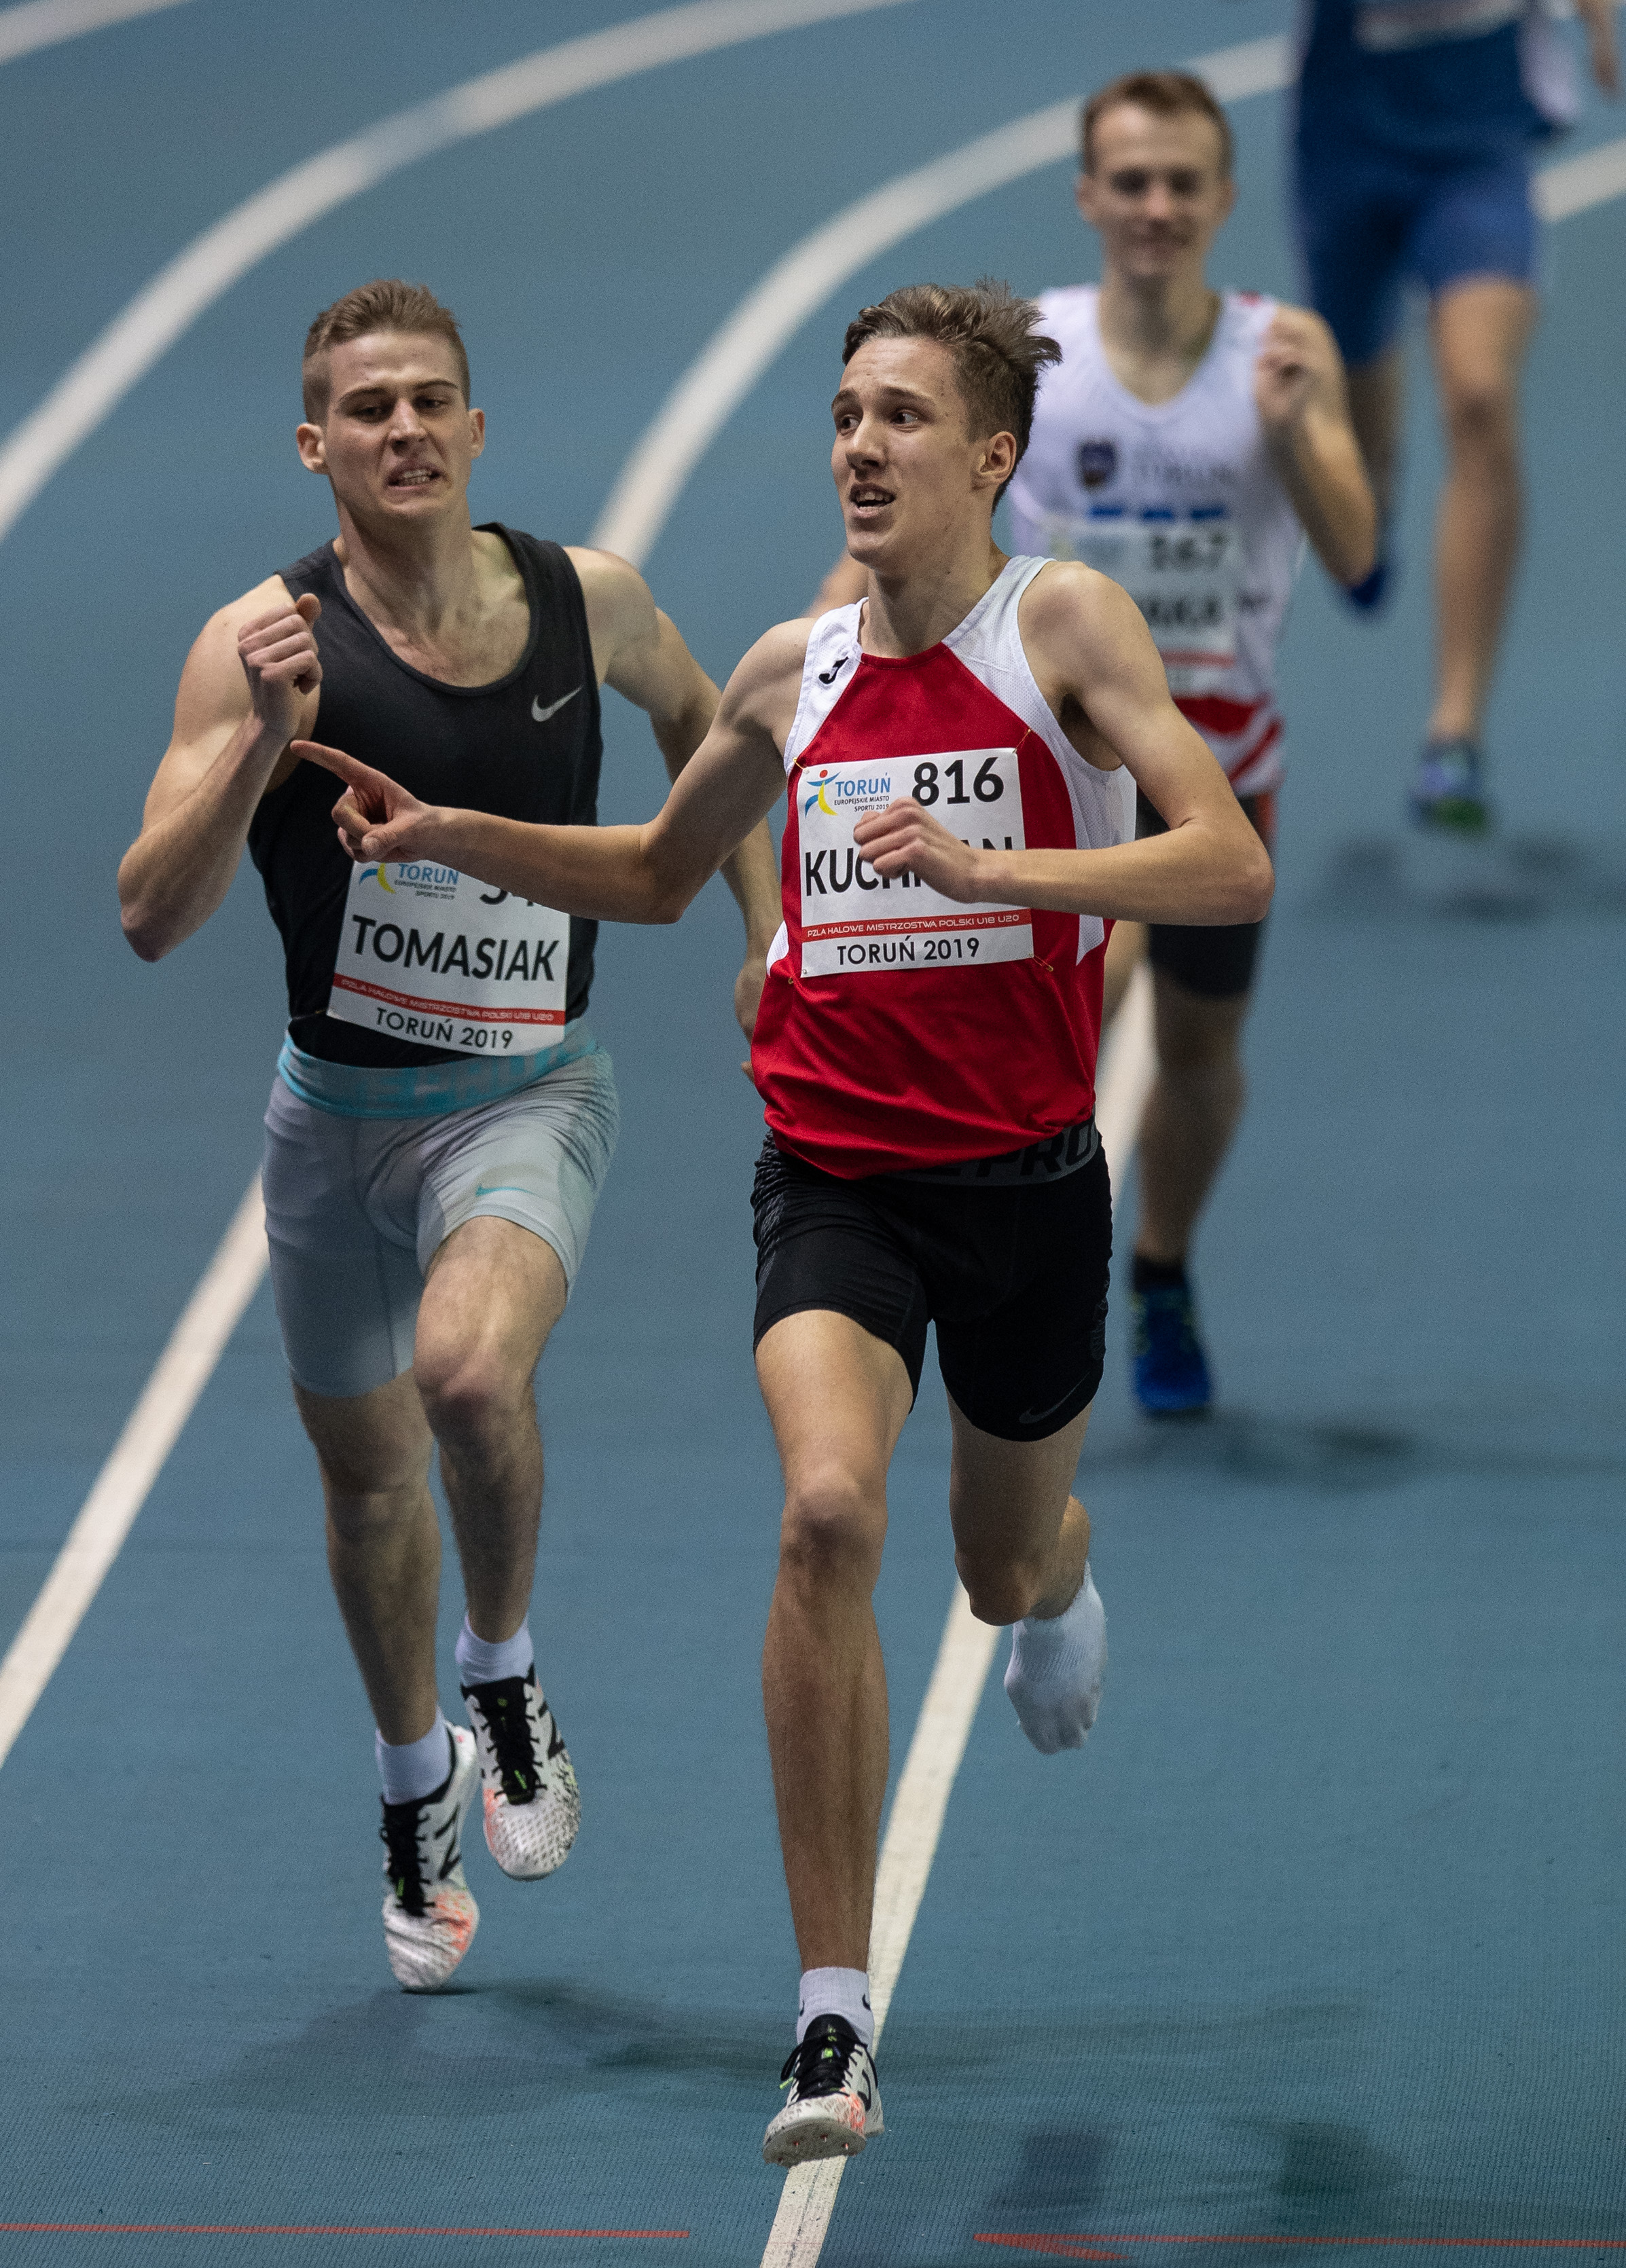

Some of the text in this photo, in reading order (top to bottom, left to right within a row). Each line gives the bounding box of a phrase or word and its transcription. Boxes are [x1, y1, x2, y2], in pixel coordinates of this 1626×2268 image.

[835, 771, 891, 798] TORUŃ
[911, 756, 1005, 807] 816
[834, 797, 869, 806] EUROPEJSKIE
[807, 914, 1019, 938] PZLA HALOWE MISTRZOSTWA POLSKI U18 U20
[352, 914, 560, 983] TOMASIAK
[836, 934, 980, 966] TORUŃ 2019
[376, 1006, 513, 1049] TORUŃ 2019
